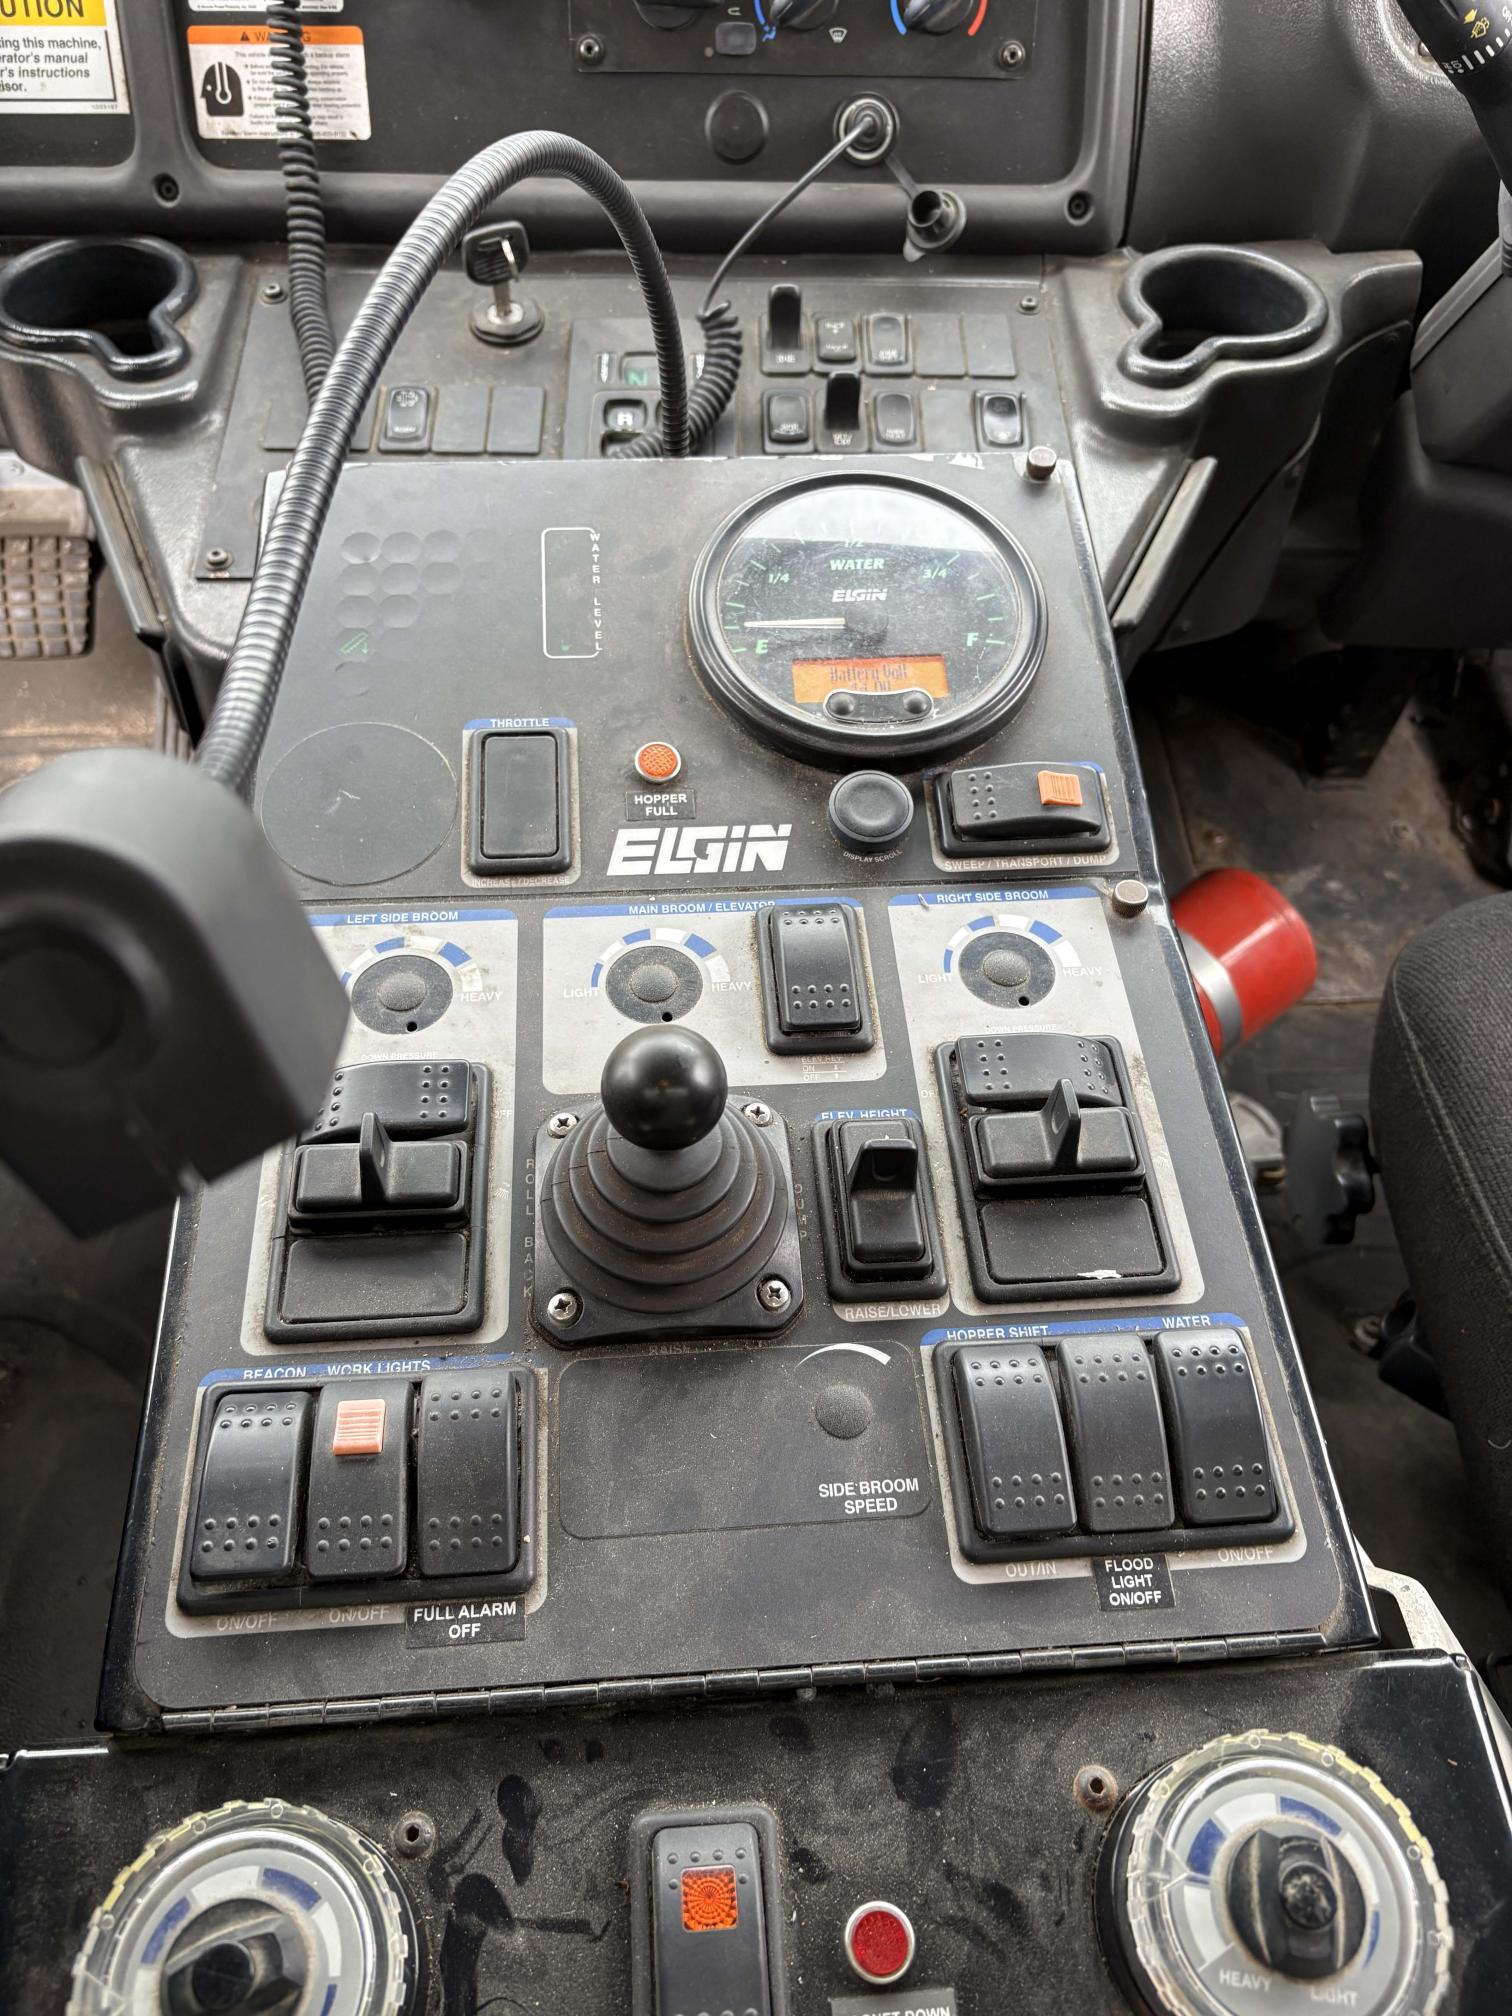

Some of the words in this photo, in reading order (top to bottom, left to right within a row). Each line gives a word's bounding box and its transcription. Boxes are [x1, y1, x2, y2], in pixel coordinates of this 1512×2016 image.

[23, 37, 45, 49] this
[48, 37, 102, 51] machine,
[44, 53, 89, 64] manual
[18, 66, 90, 78] instructions
[627, 371, 648, 386] N
[589, 533, 601, 584] WATER
[829, 558, 885, 571] WATER
[768, 571, 790, 585] 1/4
[923, 567, 948, 580] 3/4
[593, 597, 603, 652] LEVEL
[755, 639, 769, 655] E
[967, 632, 979, 648] F
[490, 718, 550, 728] THROTTLE
[634, 794, 688, 805] HOPPER
[645, 807, 678, 817] FULL
[843, 850, 873, 863] DISPLAY
[874, 850, 903, 863] SCROLL
[944, 861, 985, 870] SWEEP
[995, 857, 1062, 868] TRANSPORT
[1073, 855, 1106, 865] DUMP
[936, 894, 971, 904] RIGHT
[975, 892, 1002, 902] SIDE
[1005, 890, 1049, 901] BROOM
[629, 904, 659, 915] MAIN
[662, 903, 704, 914] BROOM
[347, 914, 378, 924] LEFT
[380, 913, 408, 923] SIDE
[412, 912, 458, 922] BROOM
[918, 973, 952, 984] LIGHT
[1063, 966, 1102, 977] HEAVY
[564, 987, 600, 999] LIGHT
[711, 981, 750, 992] HEAVY
[460, 992, 503, 1003] HEAVY
[845, 1303, 941, 1319] RAISE/LOWER
[1162, 1315, 1211, 1329] WATER
[947, 1329, 1004, 1341] HOPPER
[1010, 1325, 1049, 1338] SHIFT
[818, 1483, 855, 1497] SIDE
[860, 1478, 919, 1495] BROOM
[845, 1499, 898, 1513] SPEED
[1218, 1548, 1273, 1561] ON/OFF
[1006, 1563, 1056, 1577] OUT/IN
[1105, 1558, 1154, 1571] FLOOD
[1111, 1574, 1152, 1589] LIGHT
[1109, 1591, 1162, 1606] ON/OFF
[329, 1607, 390, 1622] ON/OFF
[414, 1605, 453, 1621] FULL
[458, 1602, 516, 1618] ALARM
[216, 1615, 278, 1630] ON/OFF
[449, 1622, 480, 1638] OFF
[1219, 1969, 1271, 1992] HEAVY
